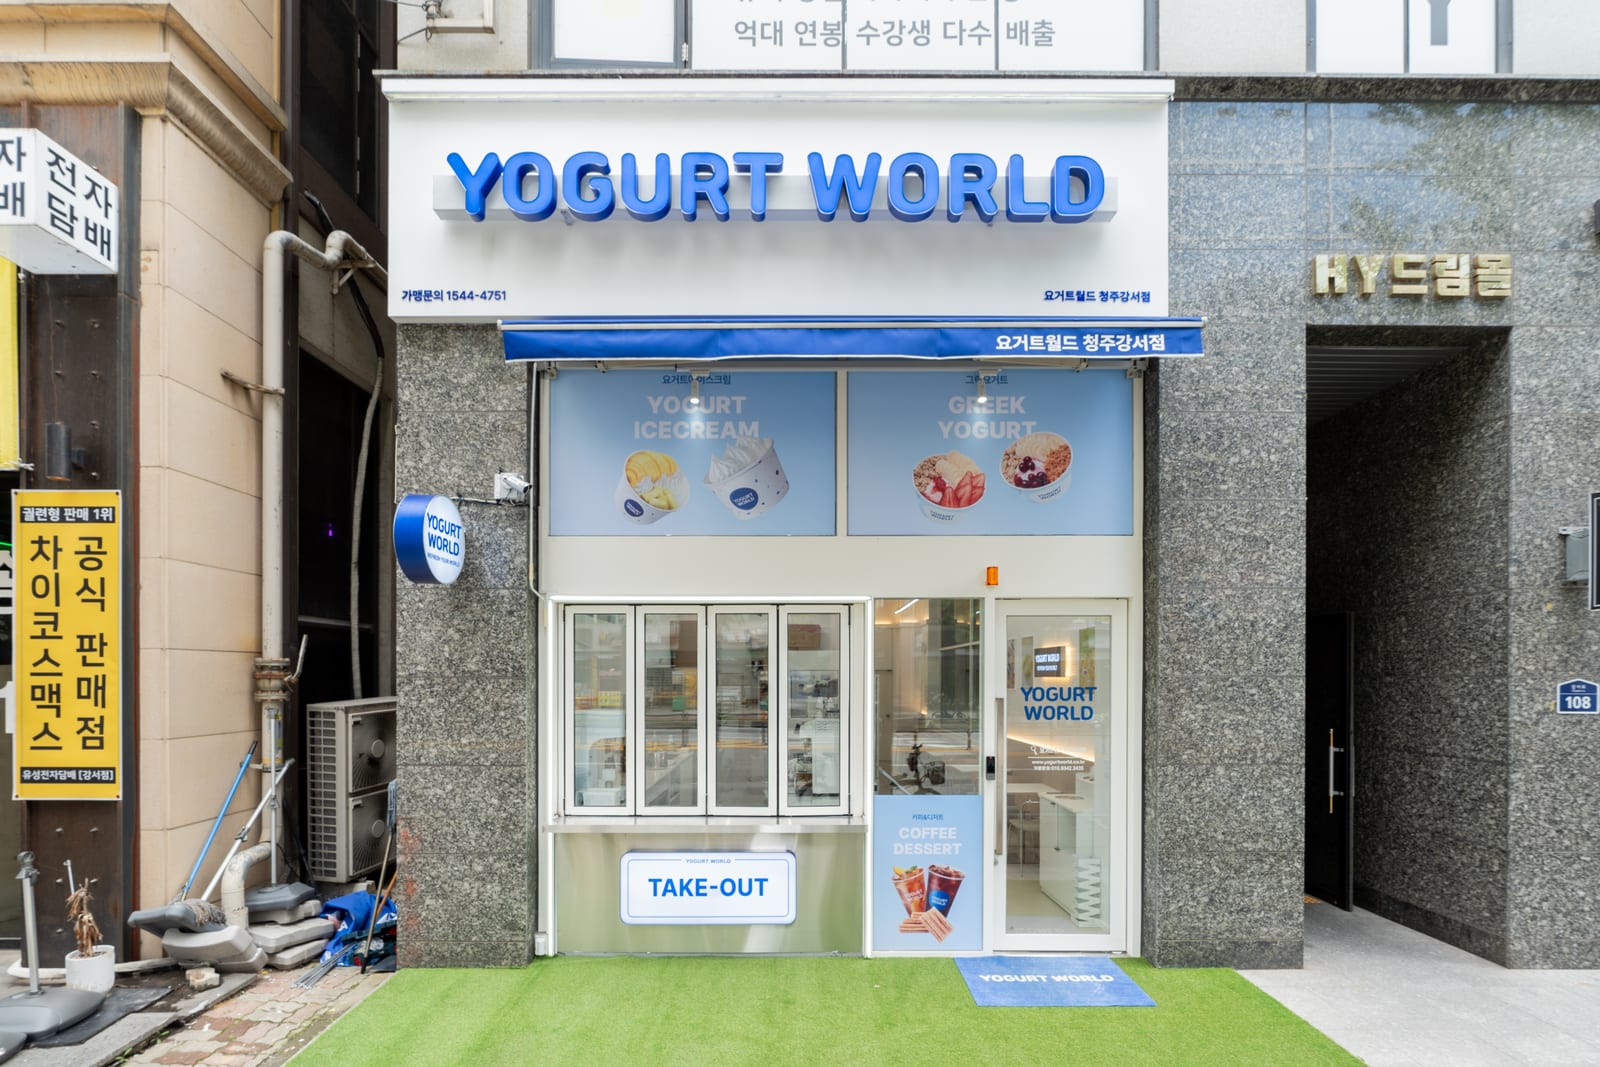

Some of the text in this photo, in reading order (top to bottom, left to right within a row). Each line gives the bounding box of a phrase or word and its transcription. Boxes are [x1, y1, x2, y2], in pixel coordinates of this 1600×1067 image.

[734, 20, 1056, 47] 억대 연봉 수강생 다수 배출
[46, 147, 112, 219] 전자
[446, 151, 1105, 223] YOGURT WORLD
[47, 191, 112, 261] 담배
[401, 289, 507, 302] 가맹문의 1544-4751
[1043, 290, 1151, 303] 요거트월드 청주강서점
[995, 334, 1166, 352] 요거트월드 청주강서점
[647, 395, 747, 414] YOGURT
[948, 395, 1026, 414] GREEK
[633, 420, 759, 440] ICECREAM
[937, 420, 1037, 440] YOGURT
[22, 507, 113, 522] 궐련형 판매 1위
[427, 512, 462, 539] YOGURT
[428, 532, 460, 556] WORLD
[29, 535, 63, 751] 차이코스맥스
[74, 535, 108, 750] 공식 판매점
[1020, 686, 1097, 702] YOGURT
[1565, 696, 1592, 709] 108
[1024, 705, 1094, 721] WORLD
[22, 769, 77, 781] 유성전자담배
[898, 827, 957, 839] COFFEE
[893, 842, 962, 855] DESSERT
[648, 877, 769, 897] TAKE-OUT
[979, 974, 1115, 983] YOGURT WORLD
